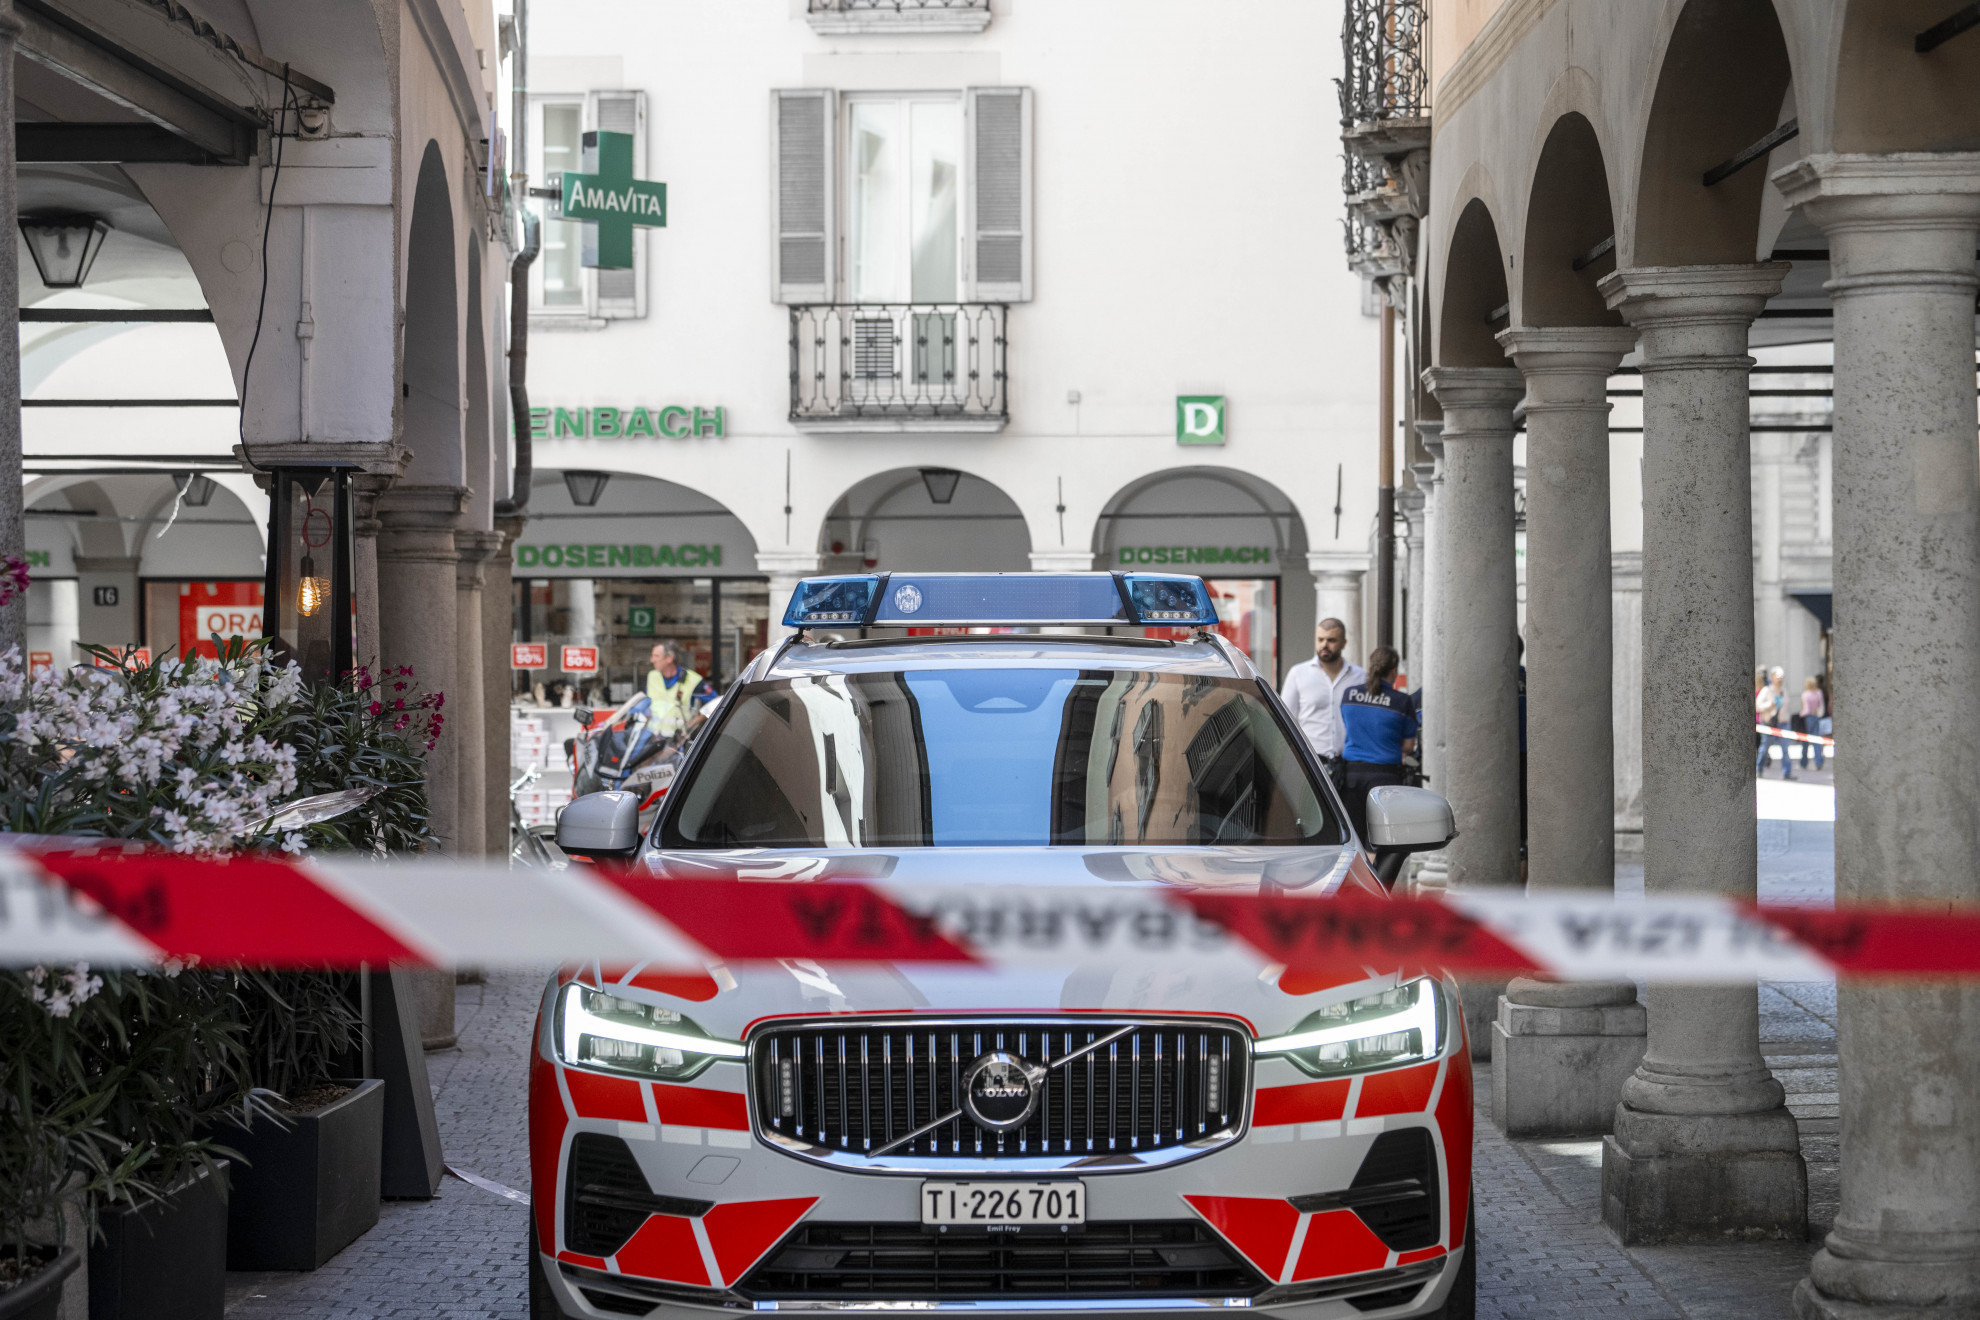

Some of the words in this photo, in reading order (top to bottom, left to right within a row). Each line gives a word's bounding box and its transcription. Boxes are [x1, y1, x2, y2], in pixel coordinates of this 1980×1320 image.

[512, 406, 725, 437] ENBACH
[1184, 402, 1219, 436] D
[517, 545, 722, 568] DOSENBACH
[1118, 547, 1270, 565] DOSENBACH
[96, 588, 117, 603] 16
[634, 610, 651, 627] D
[1349, 688, 1391, 707] Polizia
[636, 769, 673, 782] Polizia
[974, 1088, 1029, 1098] VOLVO
[1004, 1225, 1021, 1233] Frey
